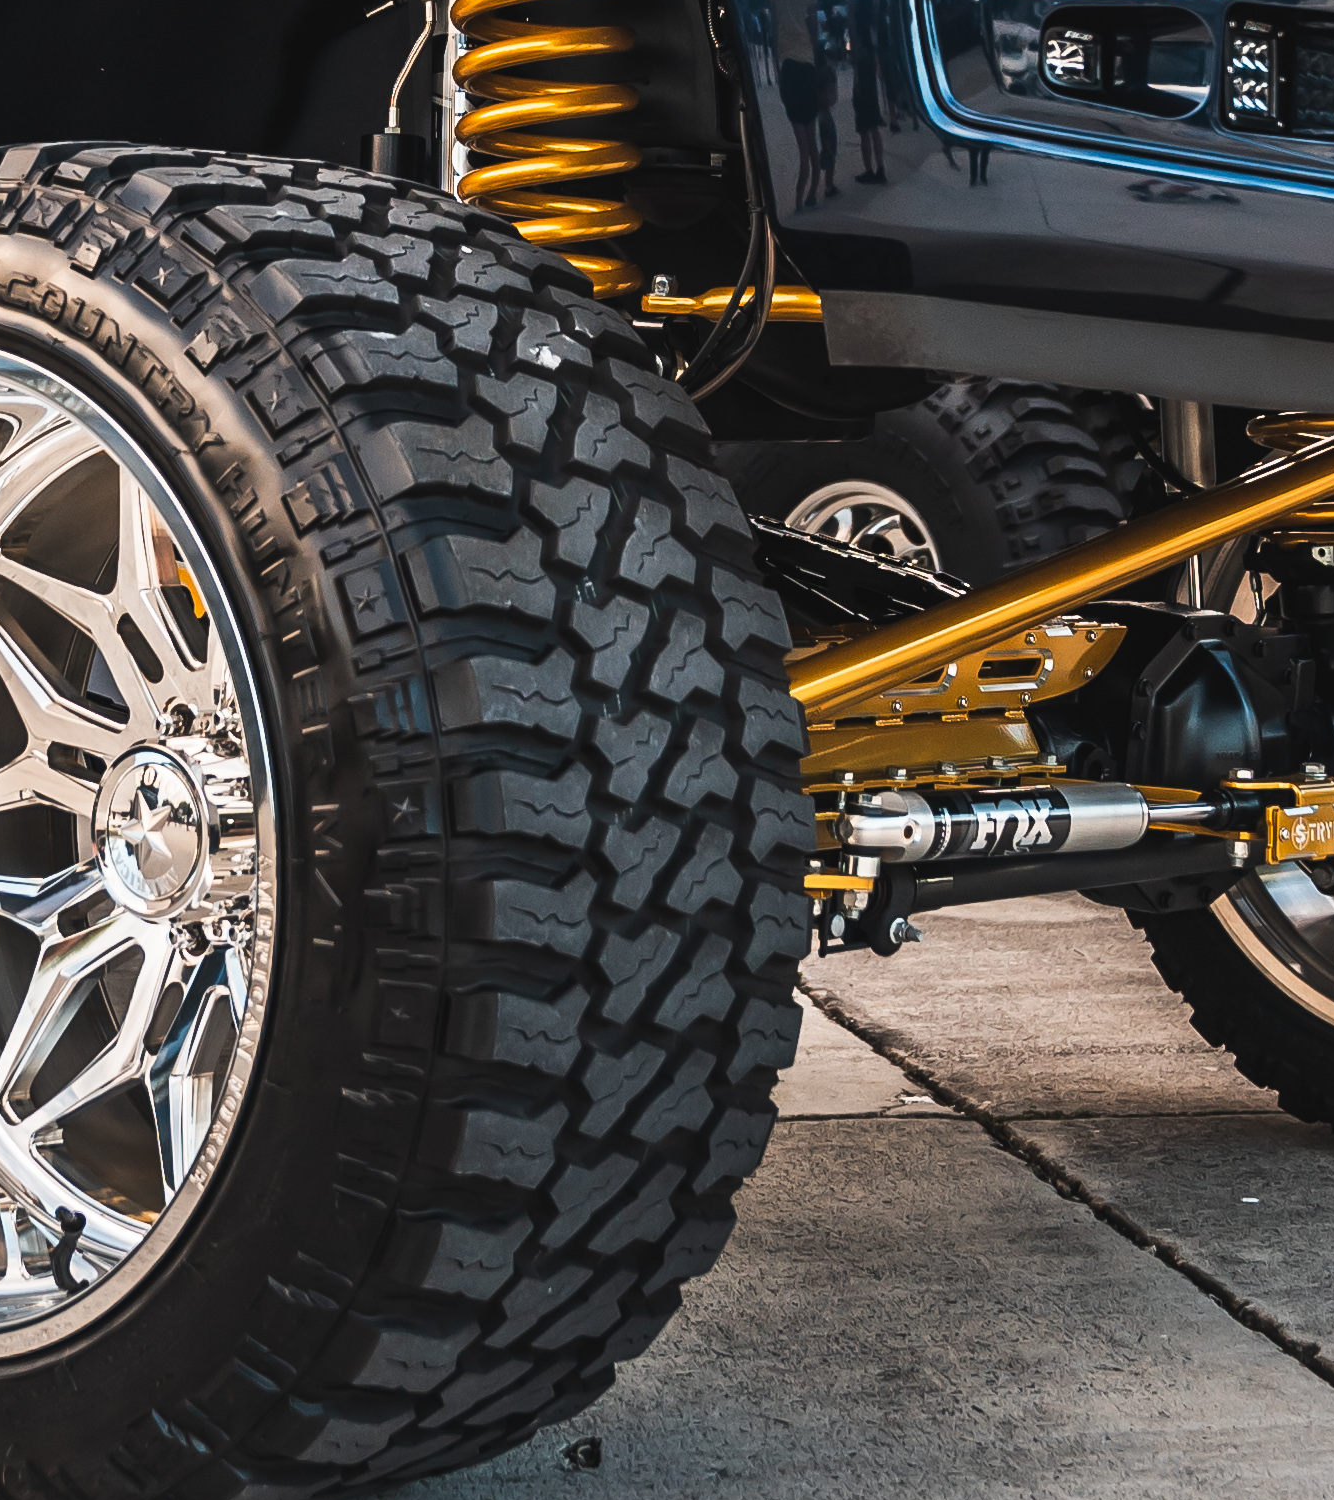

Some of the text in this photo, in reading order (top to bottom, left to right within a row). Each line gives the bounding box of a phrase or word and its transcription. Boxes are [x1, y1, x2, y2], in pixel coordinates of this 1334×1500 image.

[7, 275, 224, 453] COUNTRY
[216, 460, 335, 779] HUNTER
[970, 798, 1054, 857] FOX
[189, 1073, 244, 1192] FORCE
